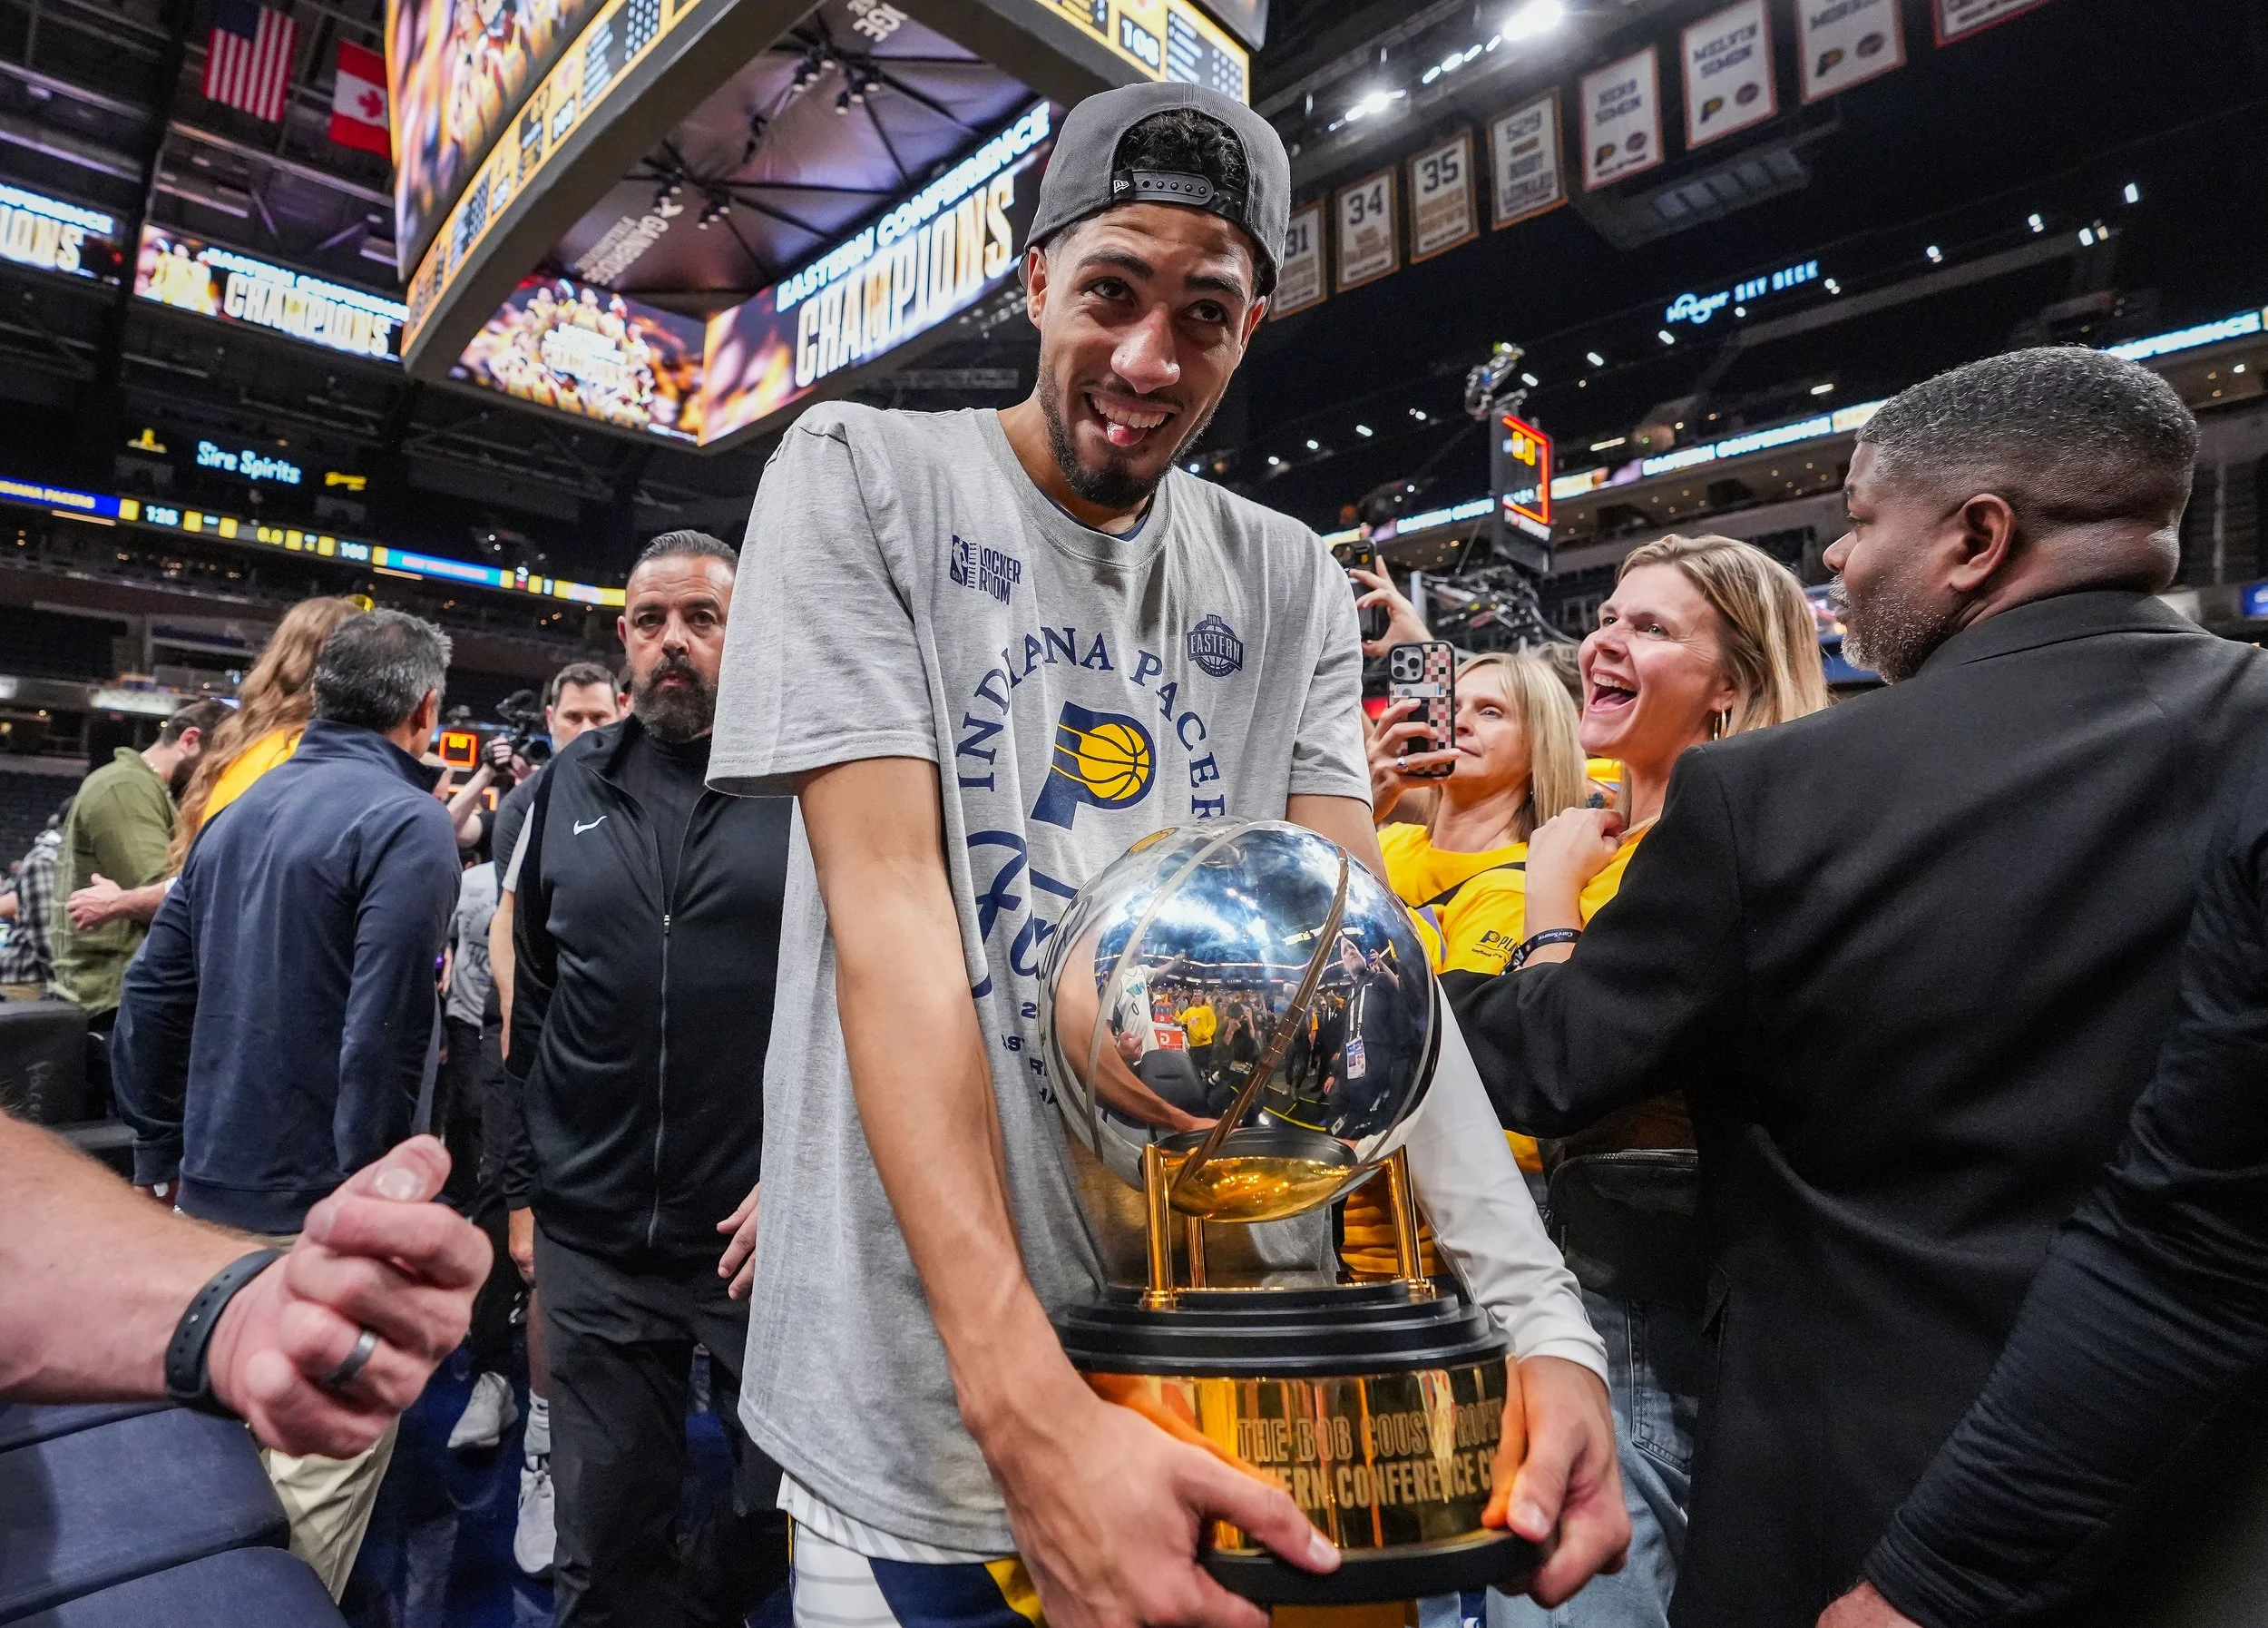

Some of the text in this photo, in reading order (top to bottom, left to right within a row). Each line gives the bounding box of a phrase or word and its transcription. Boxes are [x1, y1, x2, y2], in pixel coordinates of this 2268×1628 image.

[1421, 148, 1459, 194] 35
[776, 101, 1051, 312] EASTERN CONFERENCE
[1348, 184, 1383, 225] 34
[795, 172, 1015, 388] CHAMPIONS
[1667, 293, 1730, 324] Kroger
[1735, 276, 1768, 302] SKY
[224, 271, 393, 358] CHAMPIONS
[197, 440, 301, 485] Sire Spirits
[979, 565, 1011, 606] ROOM
[980, 544, 1022, 585] LOCKER
[1190, 633, 1240, 663] EASTERN
[955, 626, 1115, 792] INDIANA
[1237, 1417, 1288, 1463] THE
[1295, 1416, 1354, 1462] BOB
